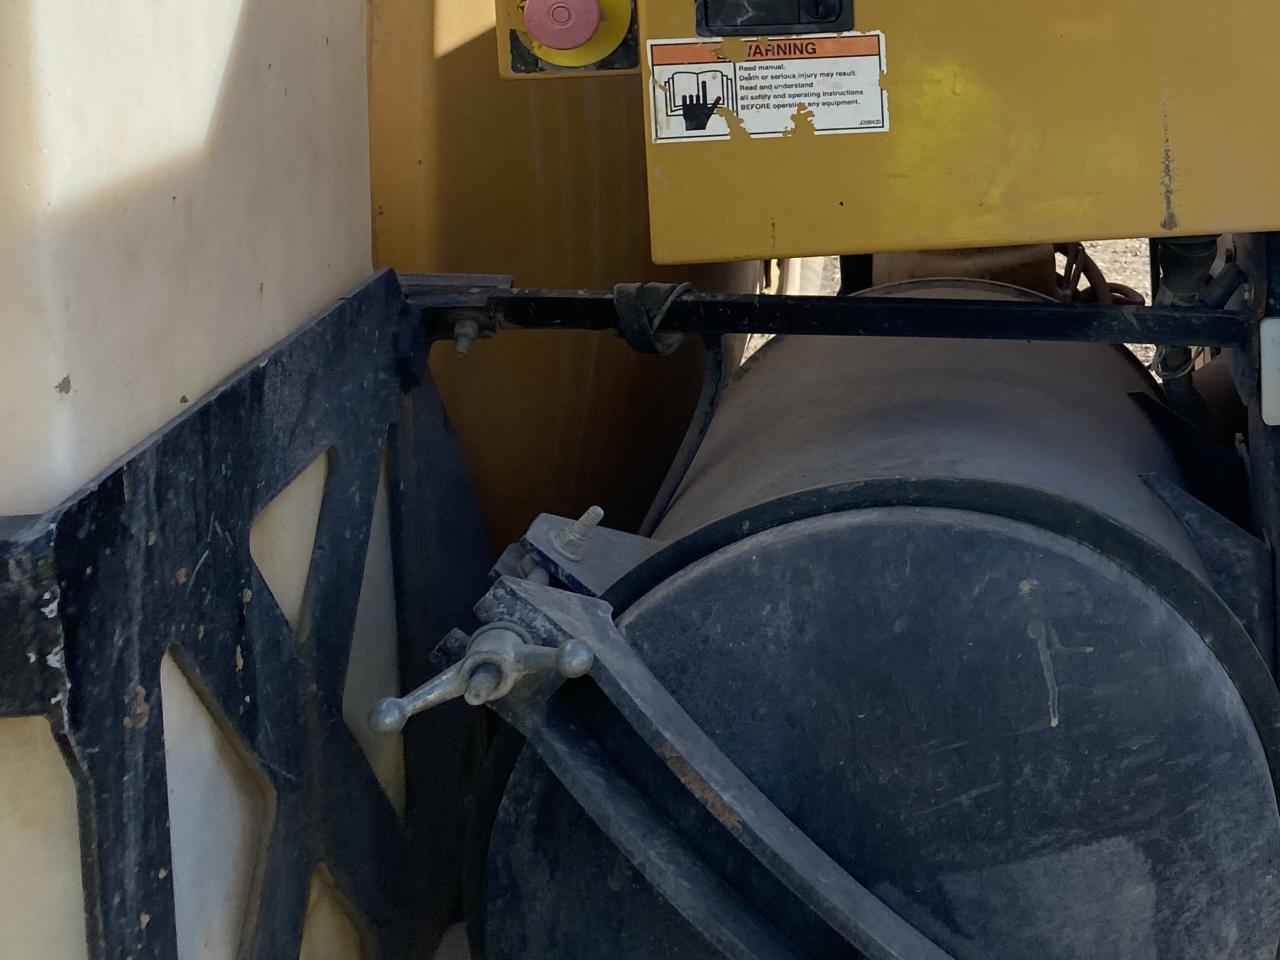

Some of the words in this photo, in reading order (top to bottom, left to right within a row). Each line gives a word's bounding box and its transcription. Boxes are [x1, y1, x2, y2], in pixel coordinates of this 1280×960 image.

[747, 41, 817, 58] ARNING
[770, 72, 796, 80] serious
[798, 72, 818, 80] injury
[819, 71, 834, 79] may
[774, 82, 813, 90] understand
[787, 91, 821, 99] operating
[822, 89, 864, 97] instructions
